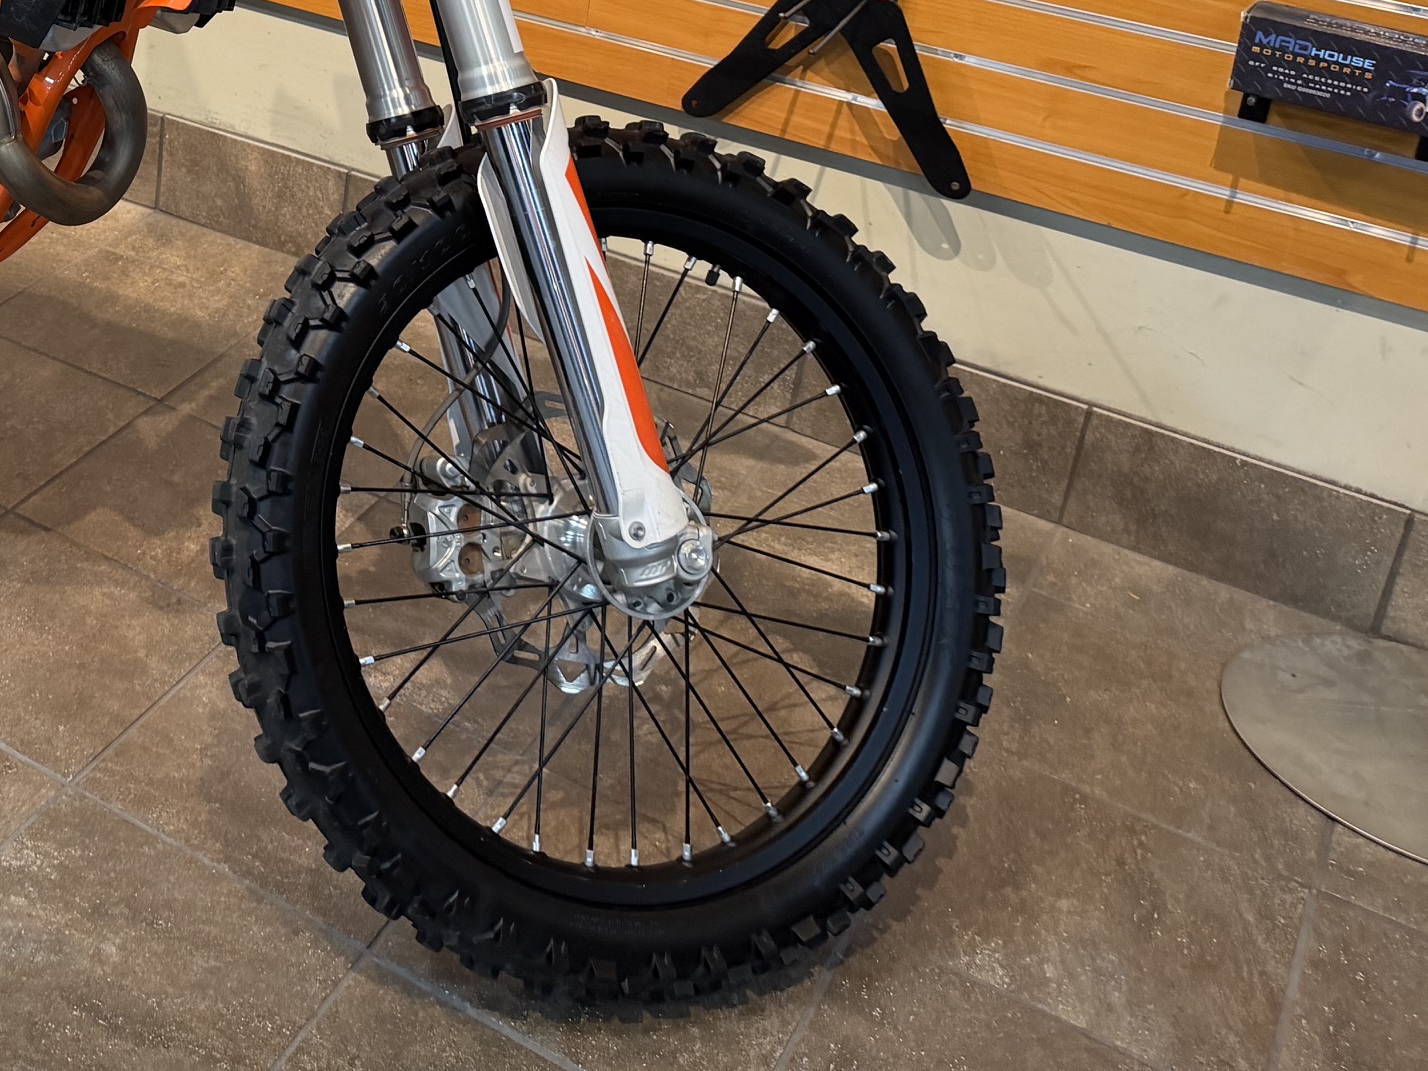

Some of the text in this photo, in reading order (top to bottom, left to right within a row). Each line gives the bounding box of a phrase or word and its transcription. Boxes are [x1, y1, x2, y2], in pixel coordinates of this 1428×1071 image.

[1250, 46, 1373, 79] MOTORSPORTS
[1254, 30, 1377, 70] MADHOUSE
[1248, 60, 1369, 93] OFF ROAD ACCESSORIES
[1267, 72, 1352, 96] WIRING HARNESS
